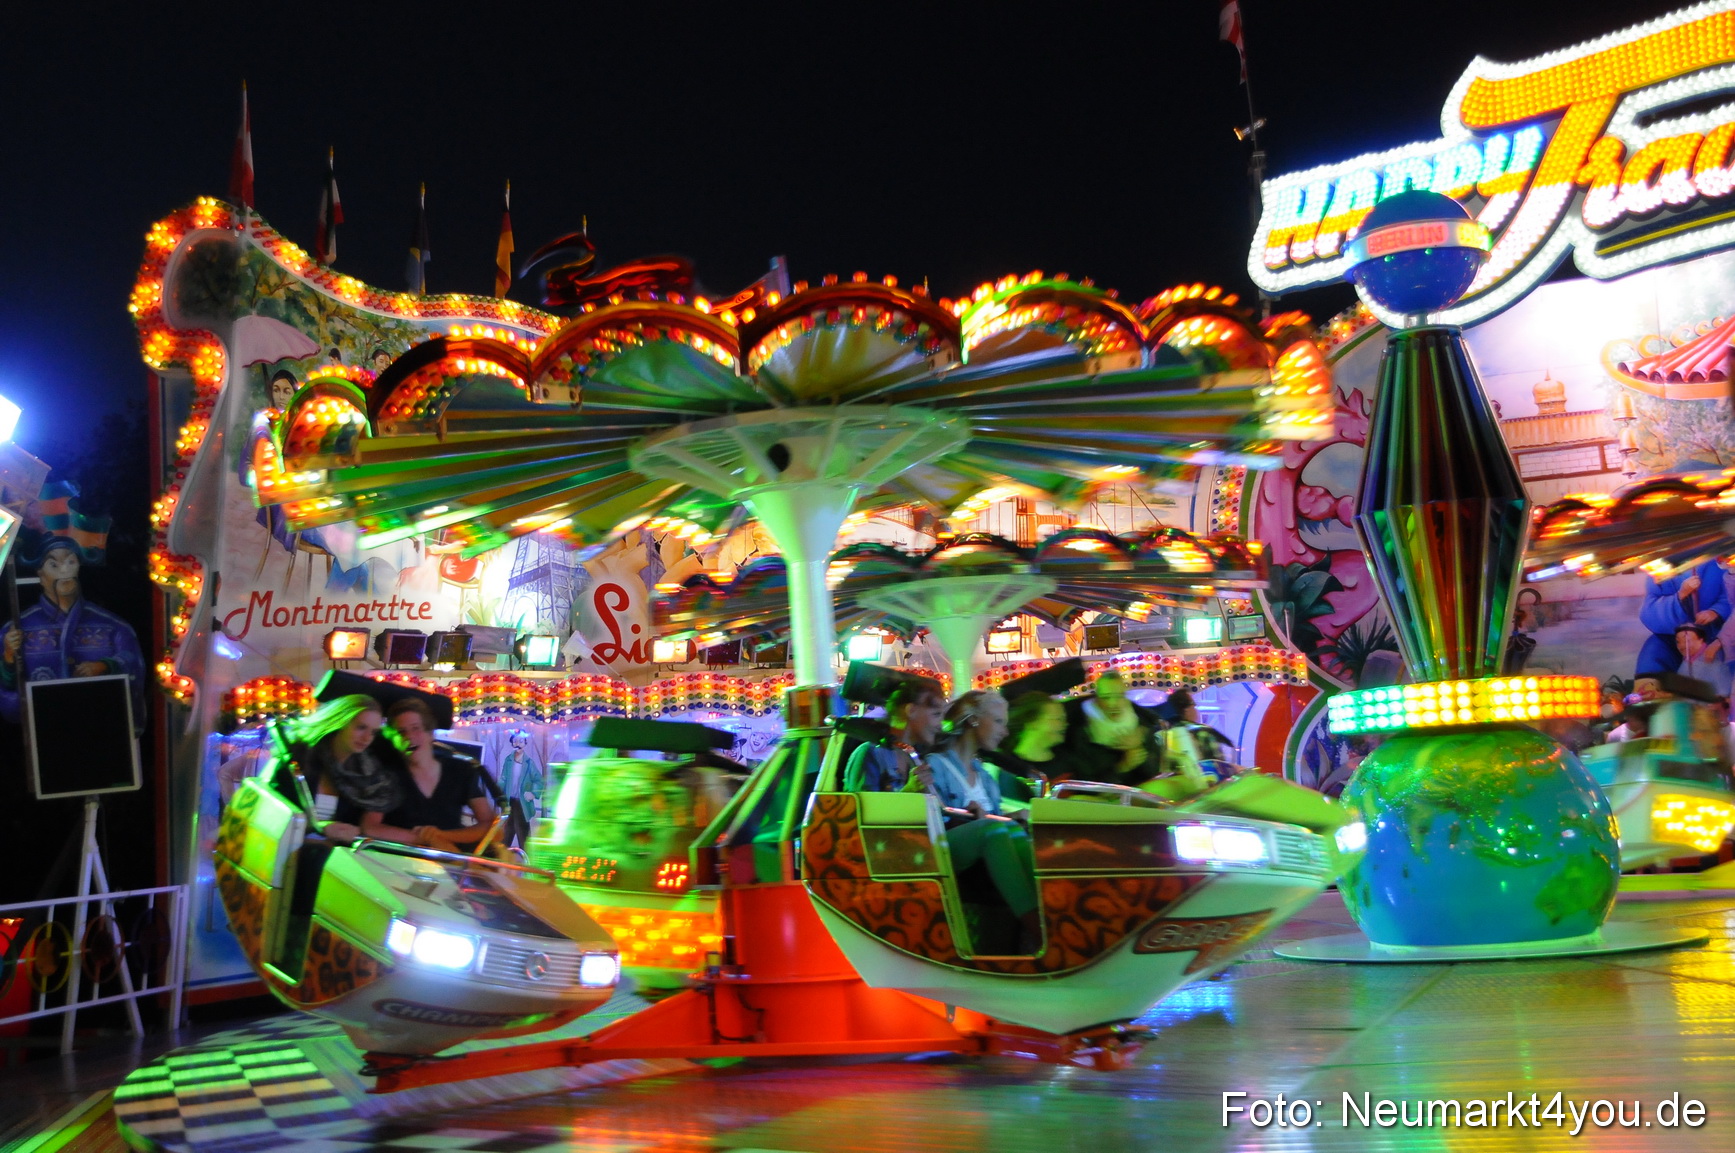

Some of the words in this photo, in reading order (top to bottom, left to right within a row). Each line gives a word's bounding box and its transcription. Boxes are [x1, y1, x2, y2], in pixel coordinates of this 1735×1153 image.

[1367, 224, 1446, 254] BERLIN
[223, 590, 433, 641] Montmartre
[591, 582, 697, 665] Li
